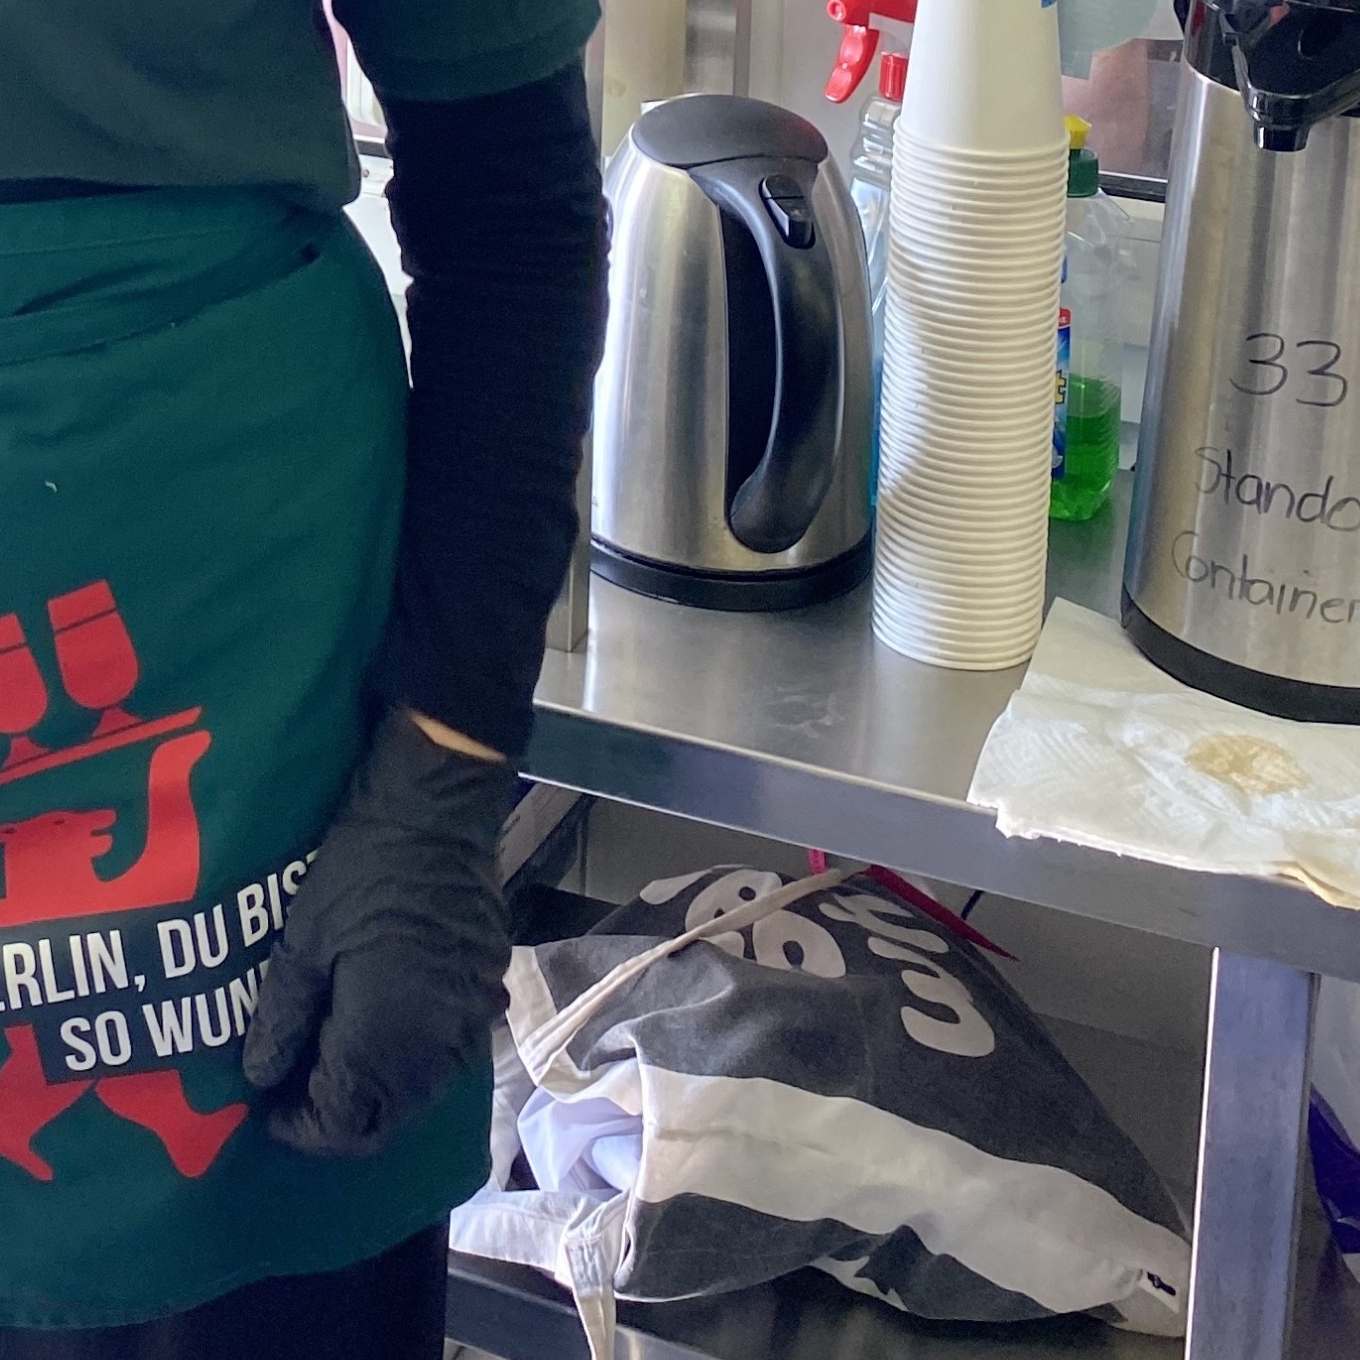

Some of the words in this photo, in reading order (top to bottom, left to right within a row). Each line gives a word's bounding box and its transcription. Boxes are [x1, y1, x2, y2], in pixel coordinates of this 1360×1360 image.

[1229, 332, 1348, 407] 33
[157, 903, 230, 980] DU
[60, 1009, 133, 1072] SO
